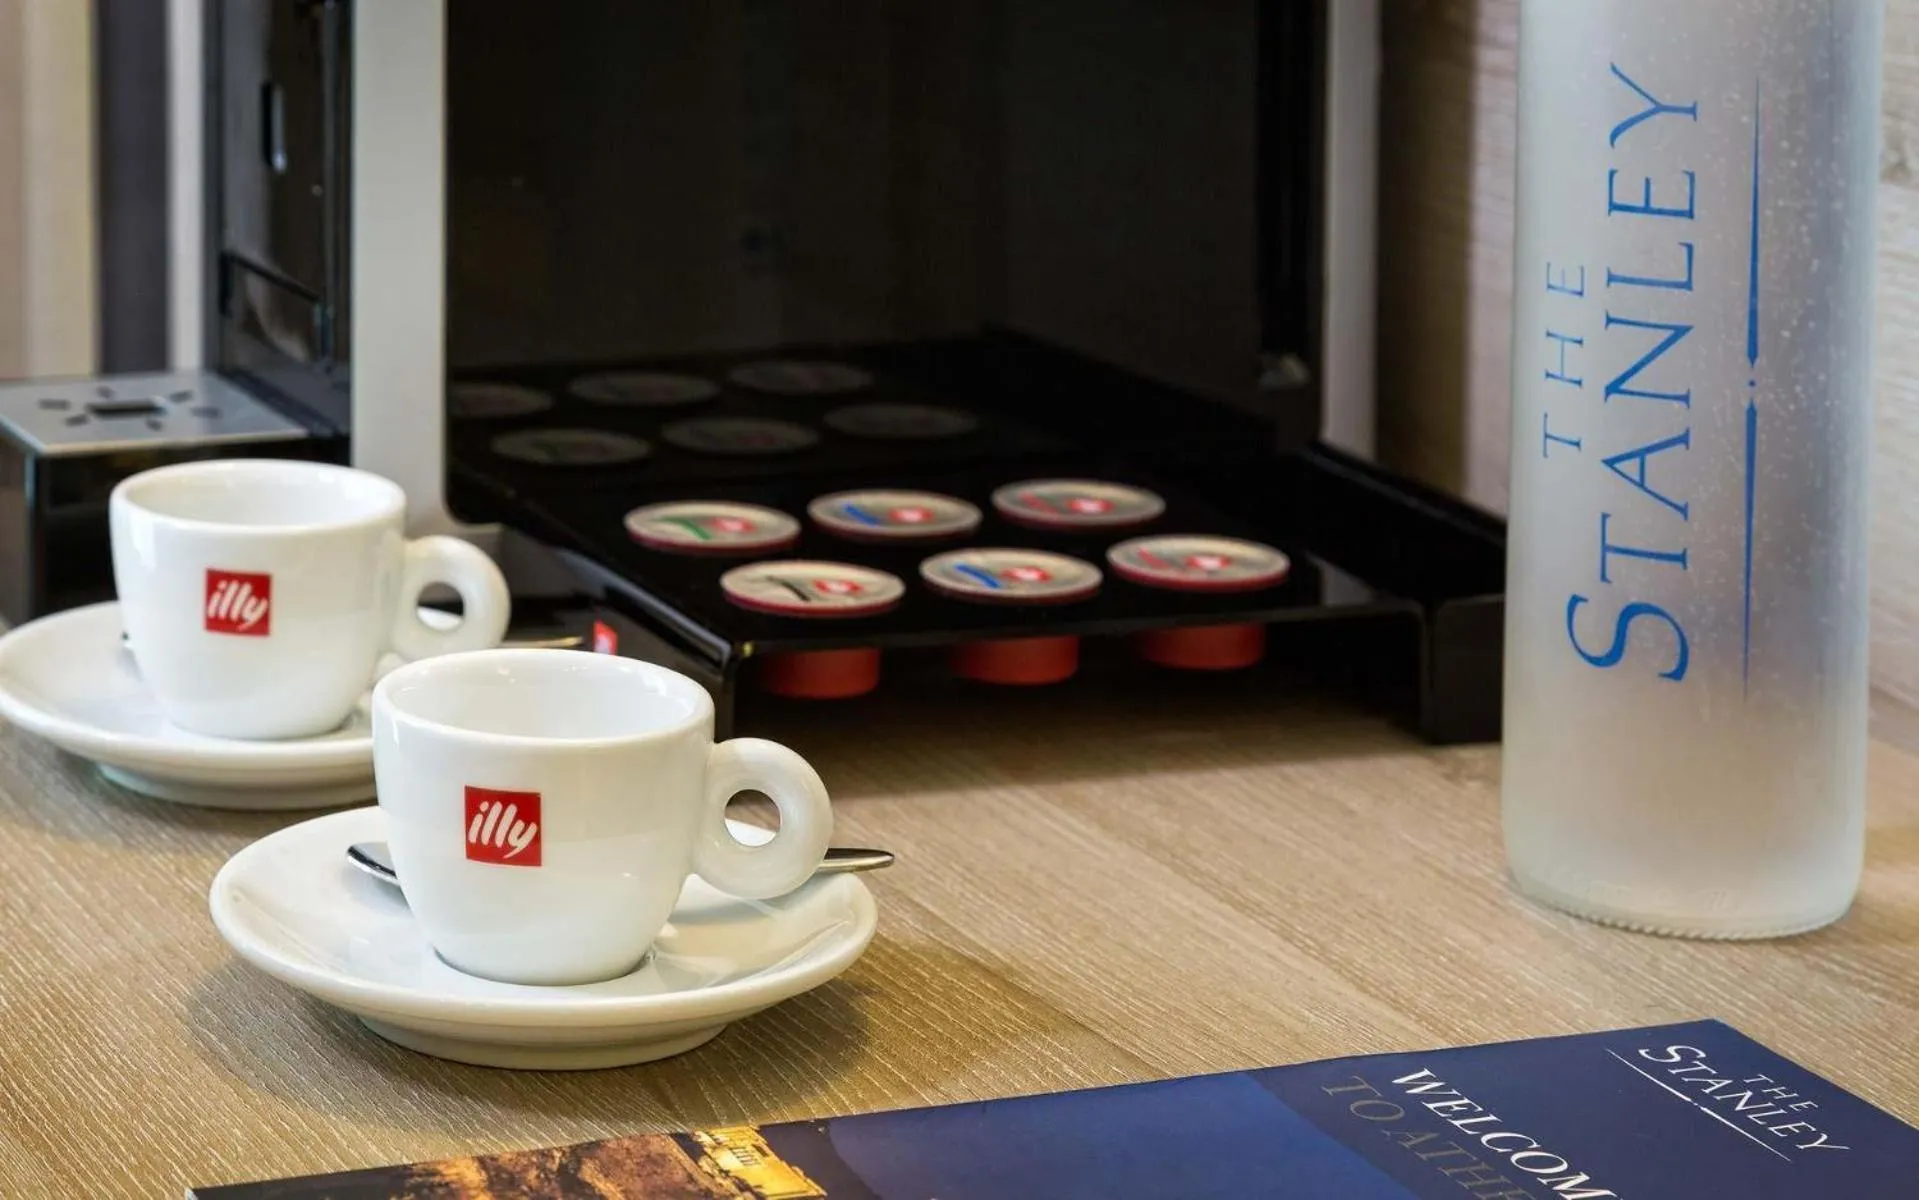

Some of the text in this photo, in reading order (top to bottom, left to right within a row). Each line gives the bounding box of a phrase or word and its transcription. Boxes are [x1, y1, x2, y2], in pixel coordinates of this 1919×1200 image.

[1543, 261, 1585, 458] THE
[1566, 61, 1698, 682] STANLEY
[207, 580, 269, 631] illy
[468, 801, 538, 860] illy
[1320, 1075, 1406, 1121] TO
[1391, 1067, 1624, 1200] WELCOM
[1638, 1045, 1851, 1151] STANLEY
[1743, 1073, 1819, 1112] THE
